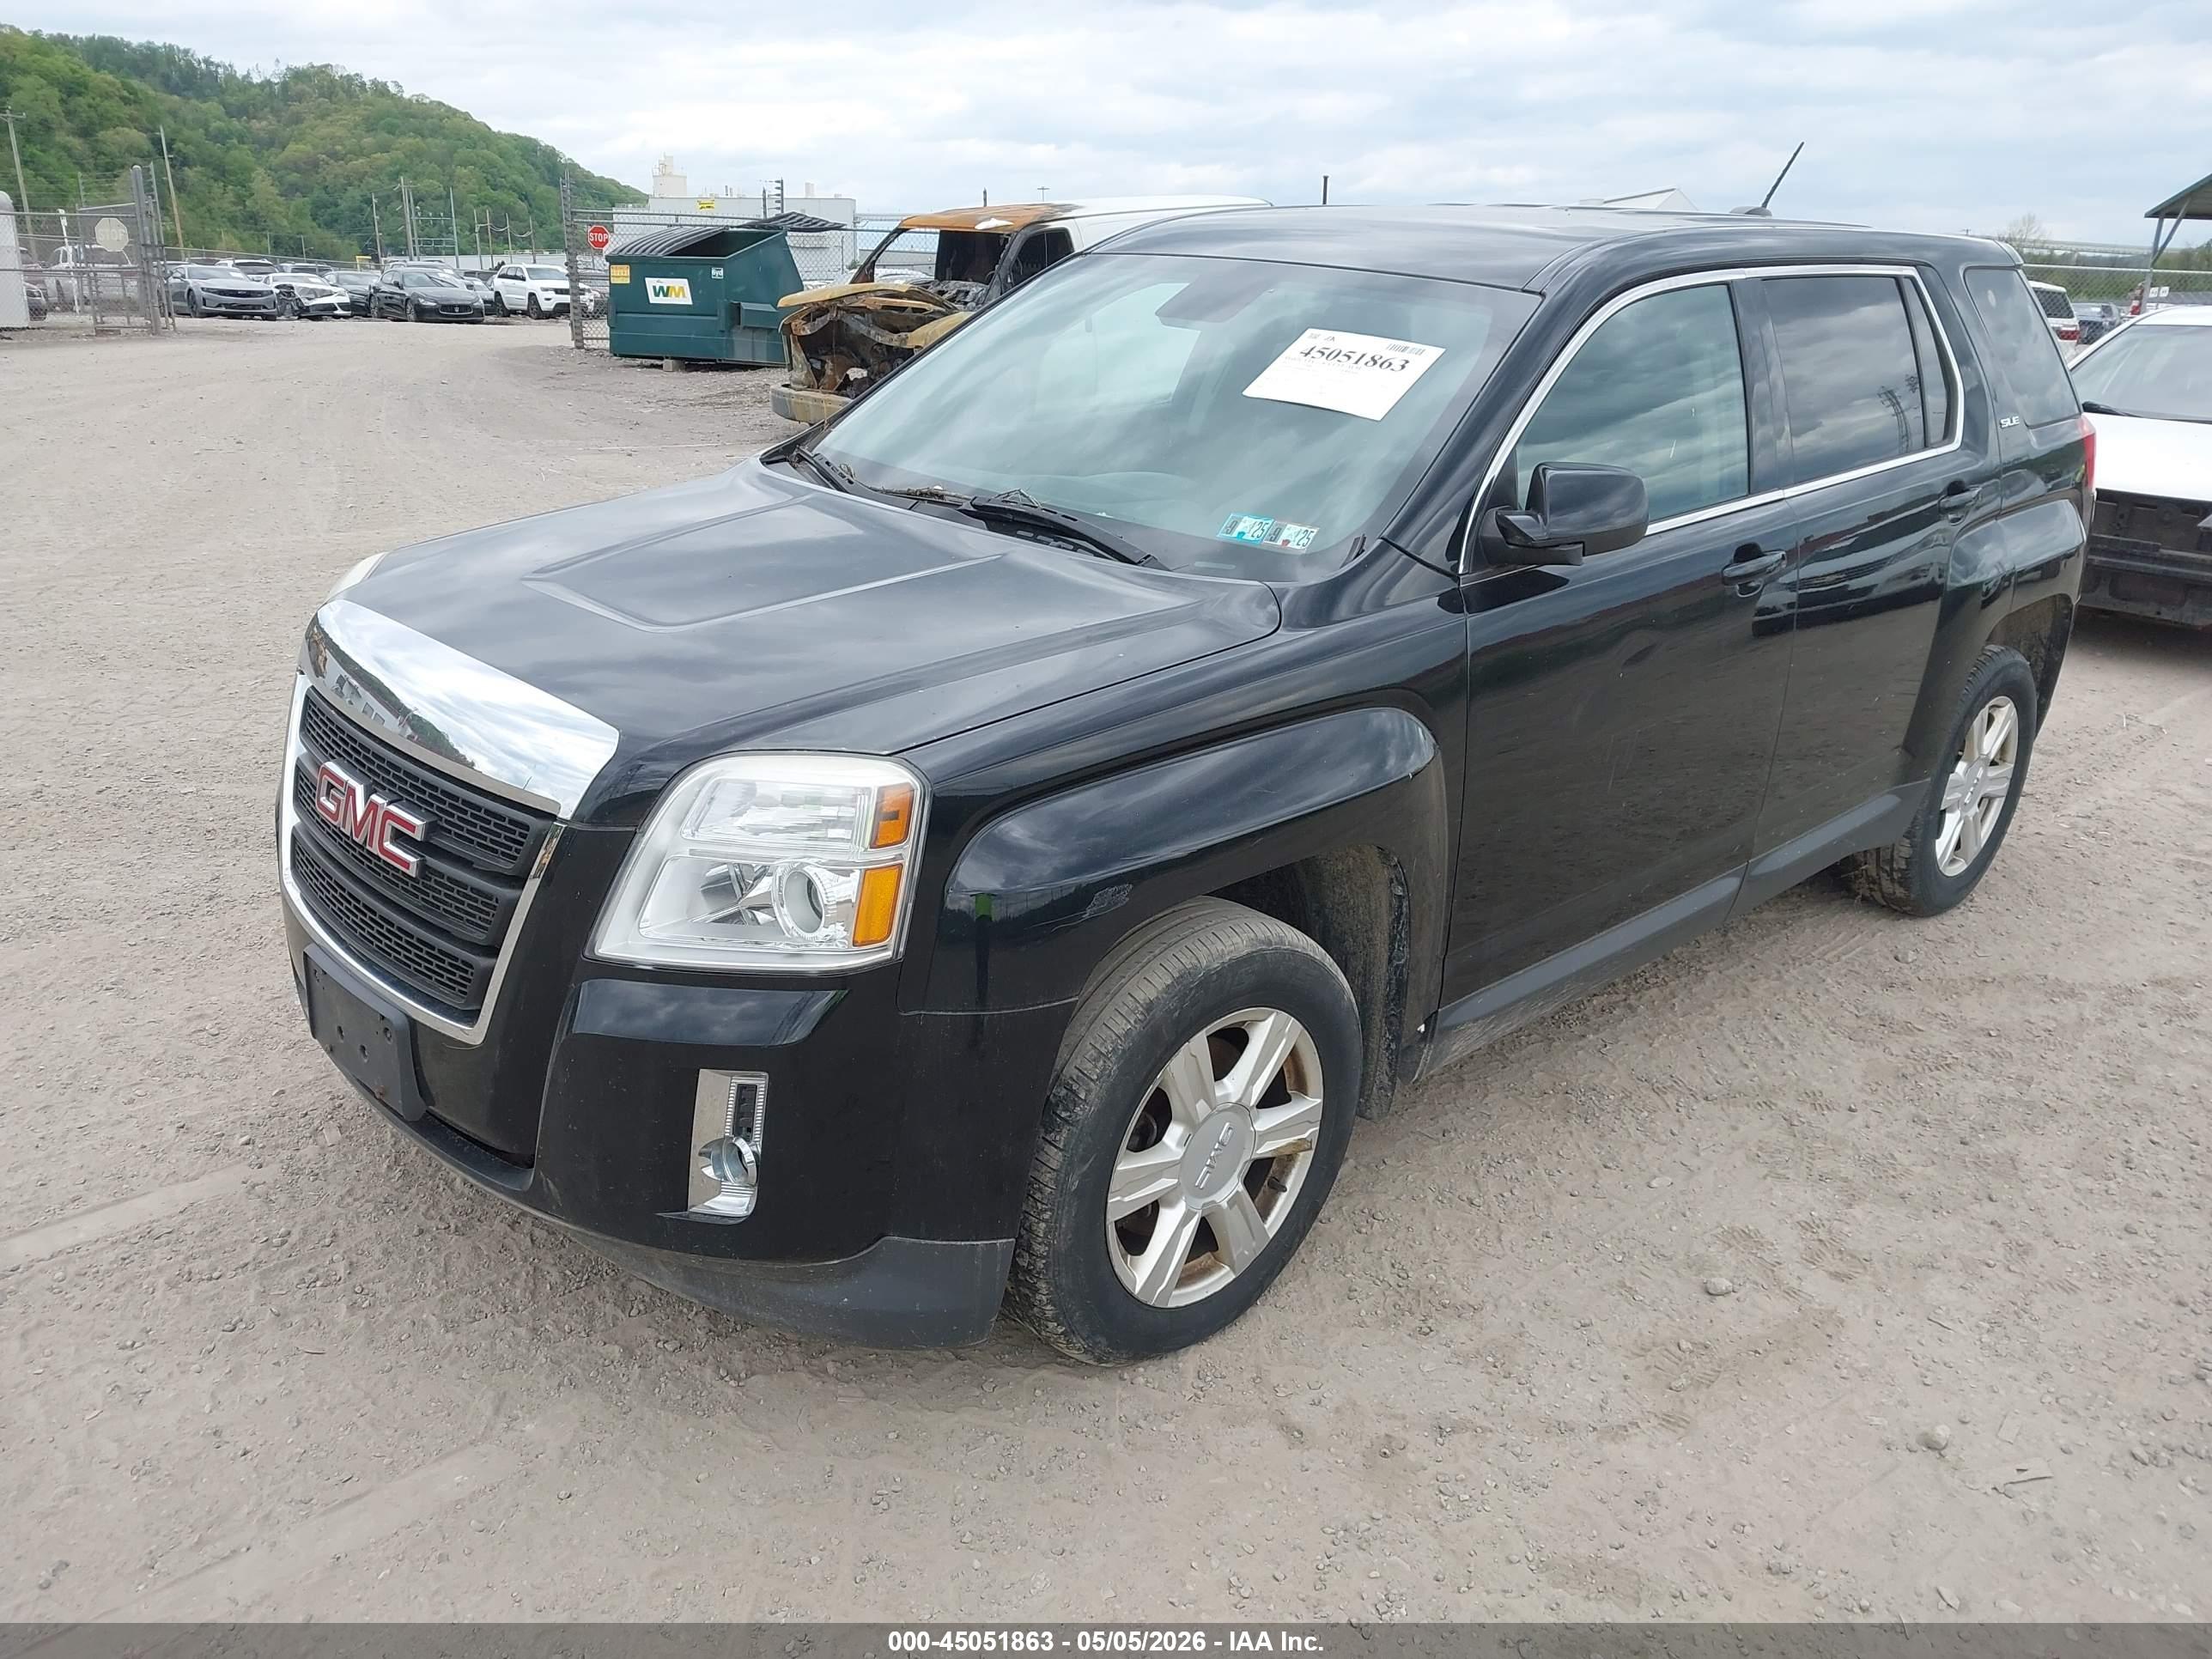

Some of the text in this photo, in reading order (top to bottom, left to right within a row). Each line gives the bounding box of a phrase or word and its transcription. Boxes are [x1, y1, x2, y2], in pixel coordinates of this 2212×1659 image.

[589, 233, 608, 242] STOP
[653, 285, 686, 298] WM
[1299, 345, 1410, 373] 45051863
[2000, 416, 2020, 428] SLE
[316, 761, 427, 878] GMC
